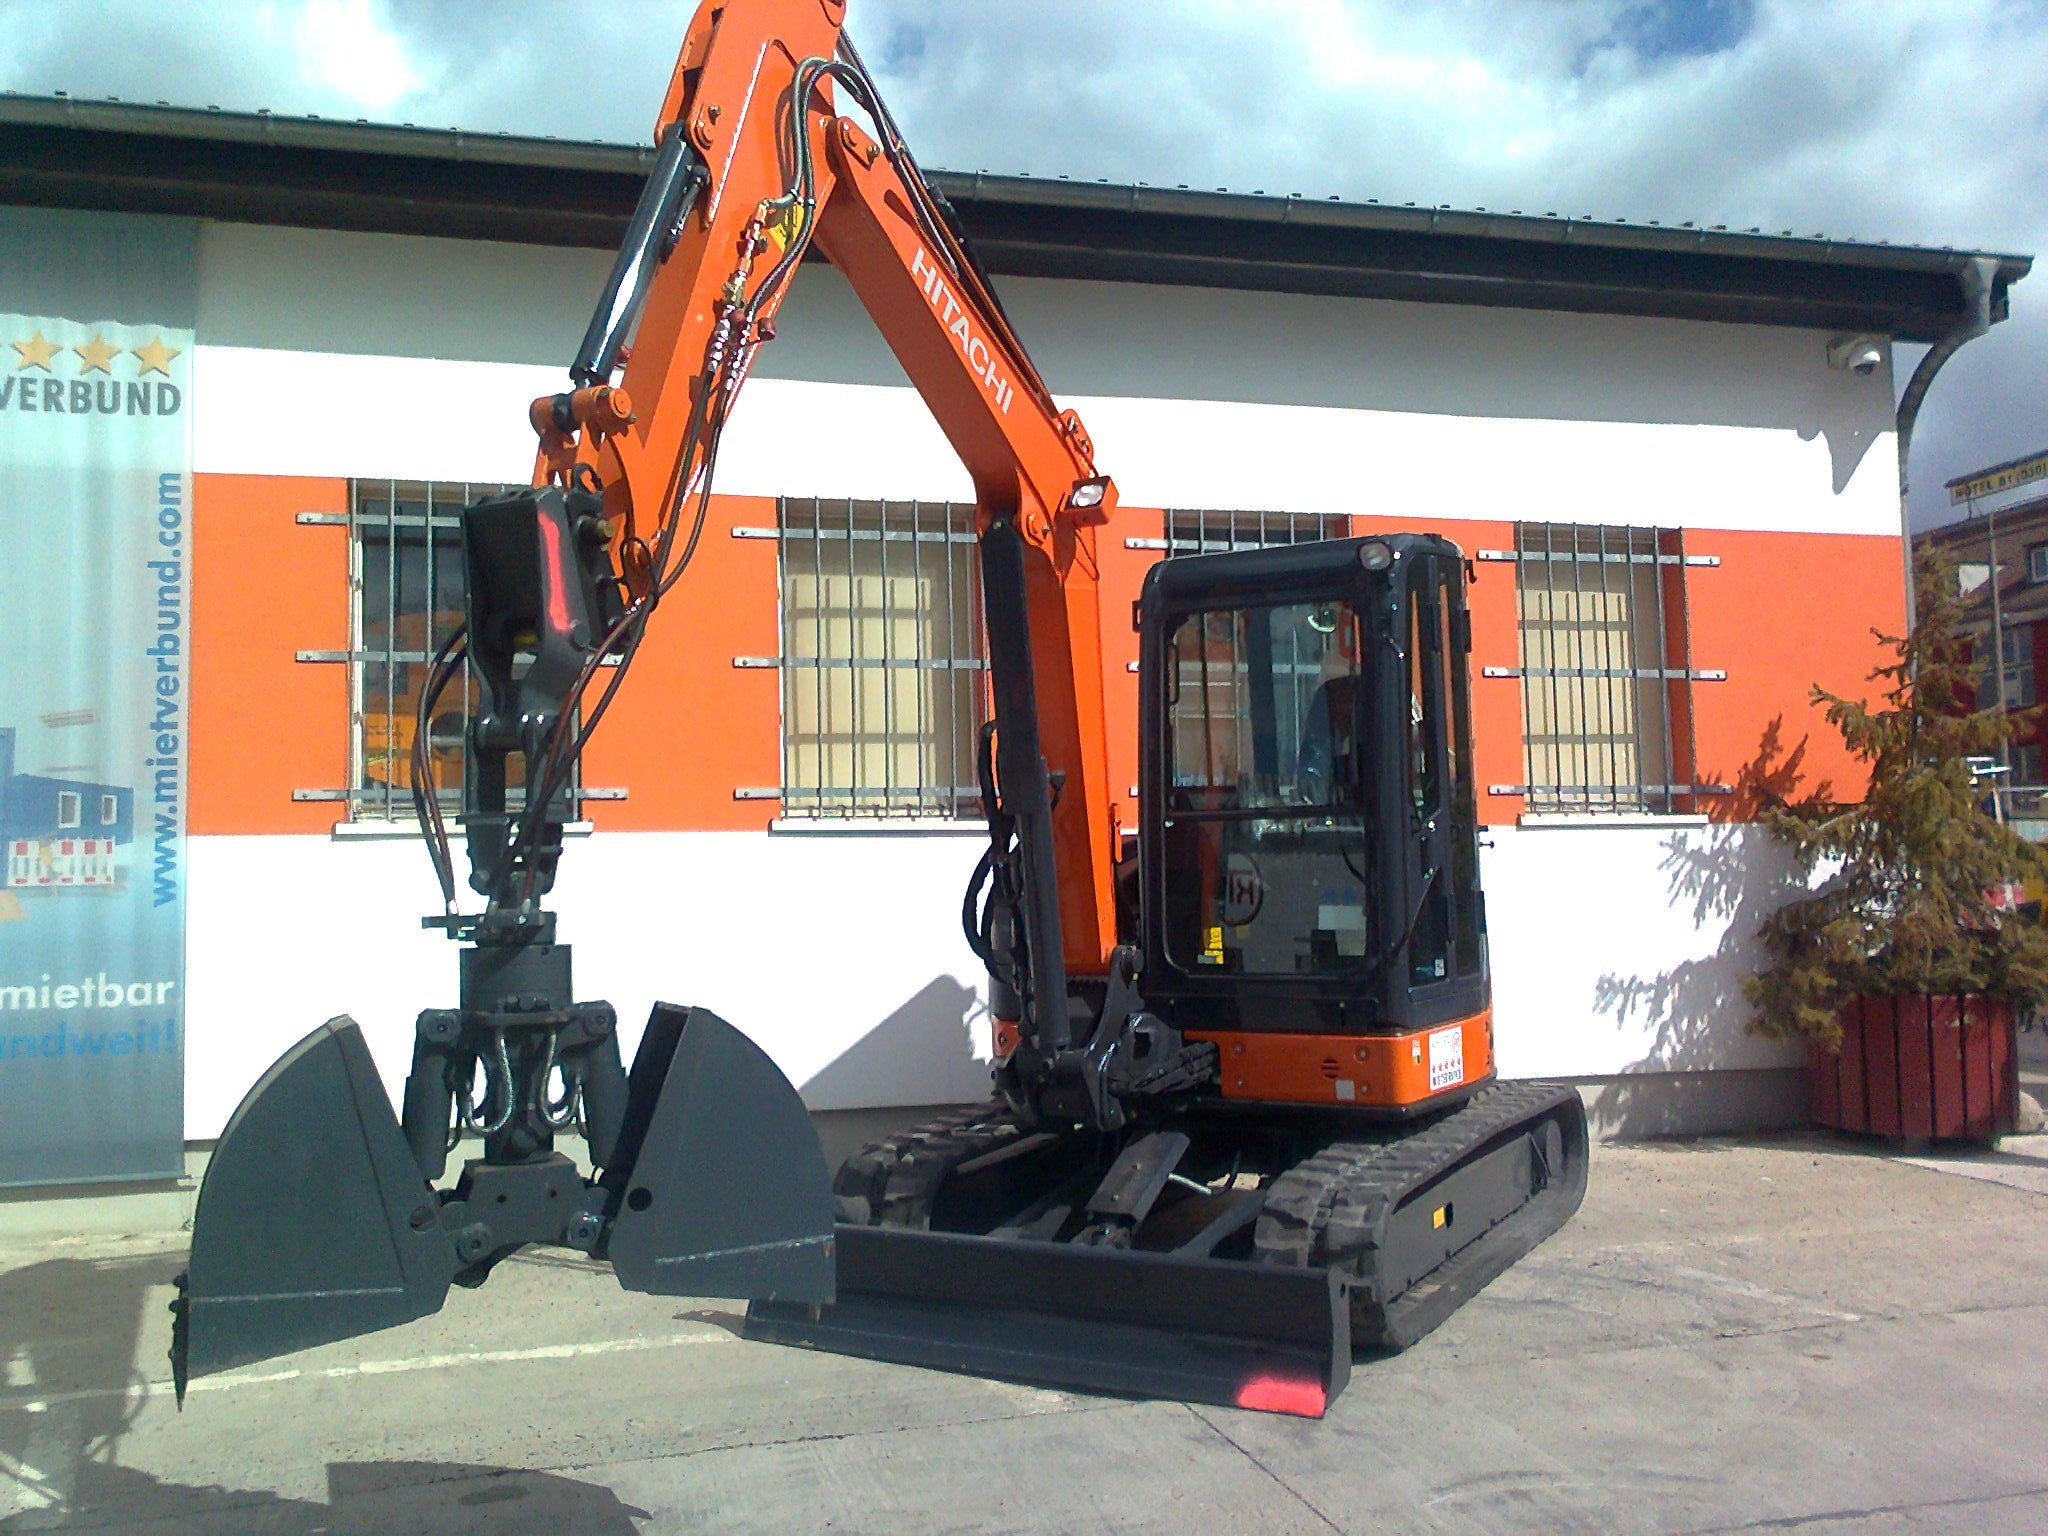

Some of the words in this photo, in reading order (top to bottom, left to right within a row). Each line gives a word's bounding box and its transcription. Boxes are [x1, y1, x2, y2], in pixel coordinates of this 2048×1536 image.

[911, 246, 1013, 415] HITACHI
[0, 375, 182, 416] VERBUND
[147, 472, 183, 908] www.mietverbund.com
[0, 972, 175, 1010] mietbar
[0, 1018, 175, 1058] ndweit!
